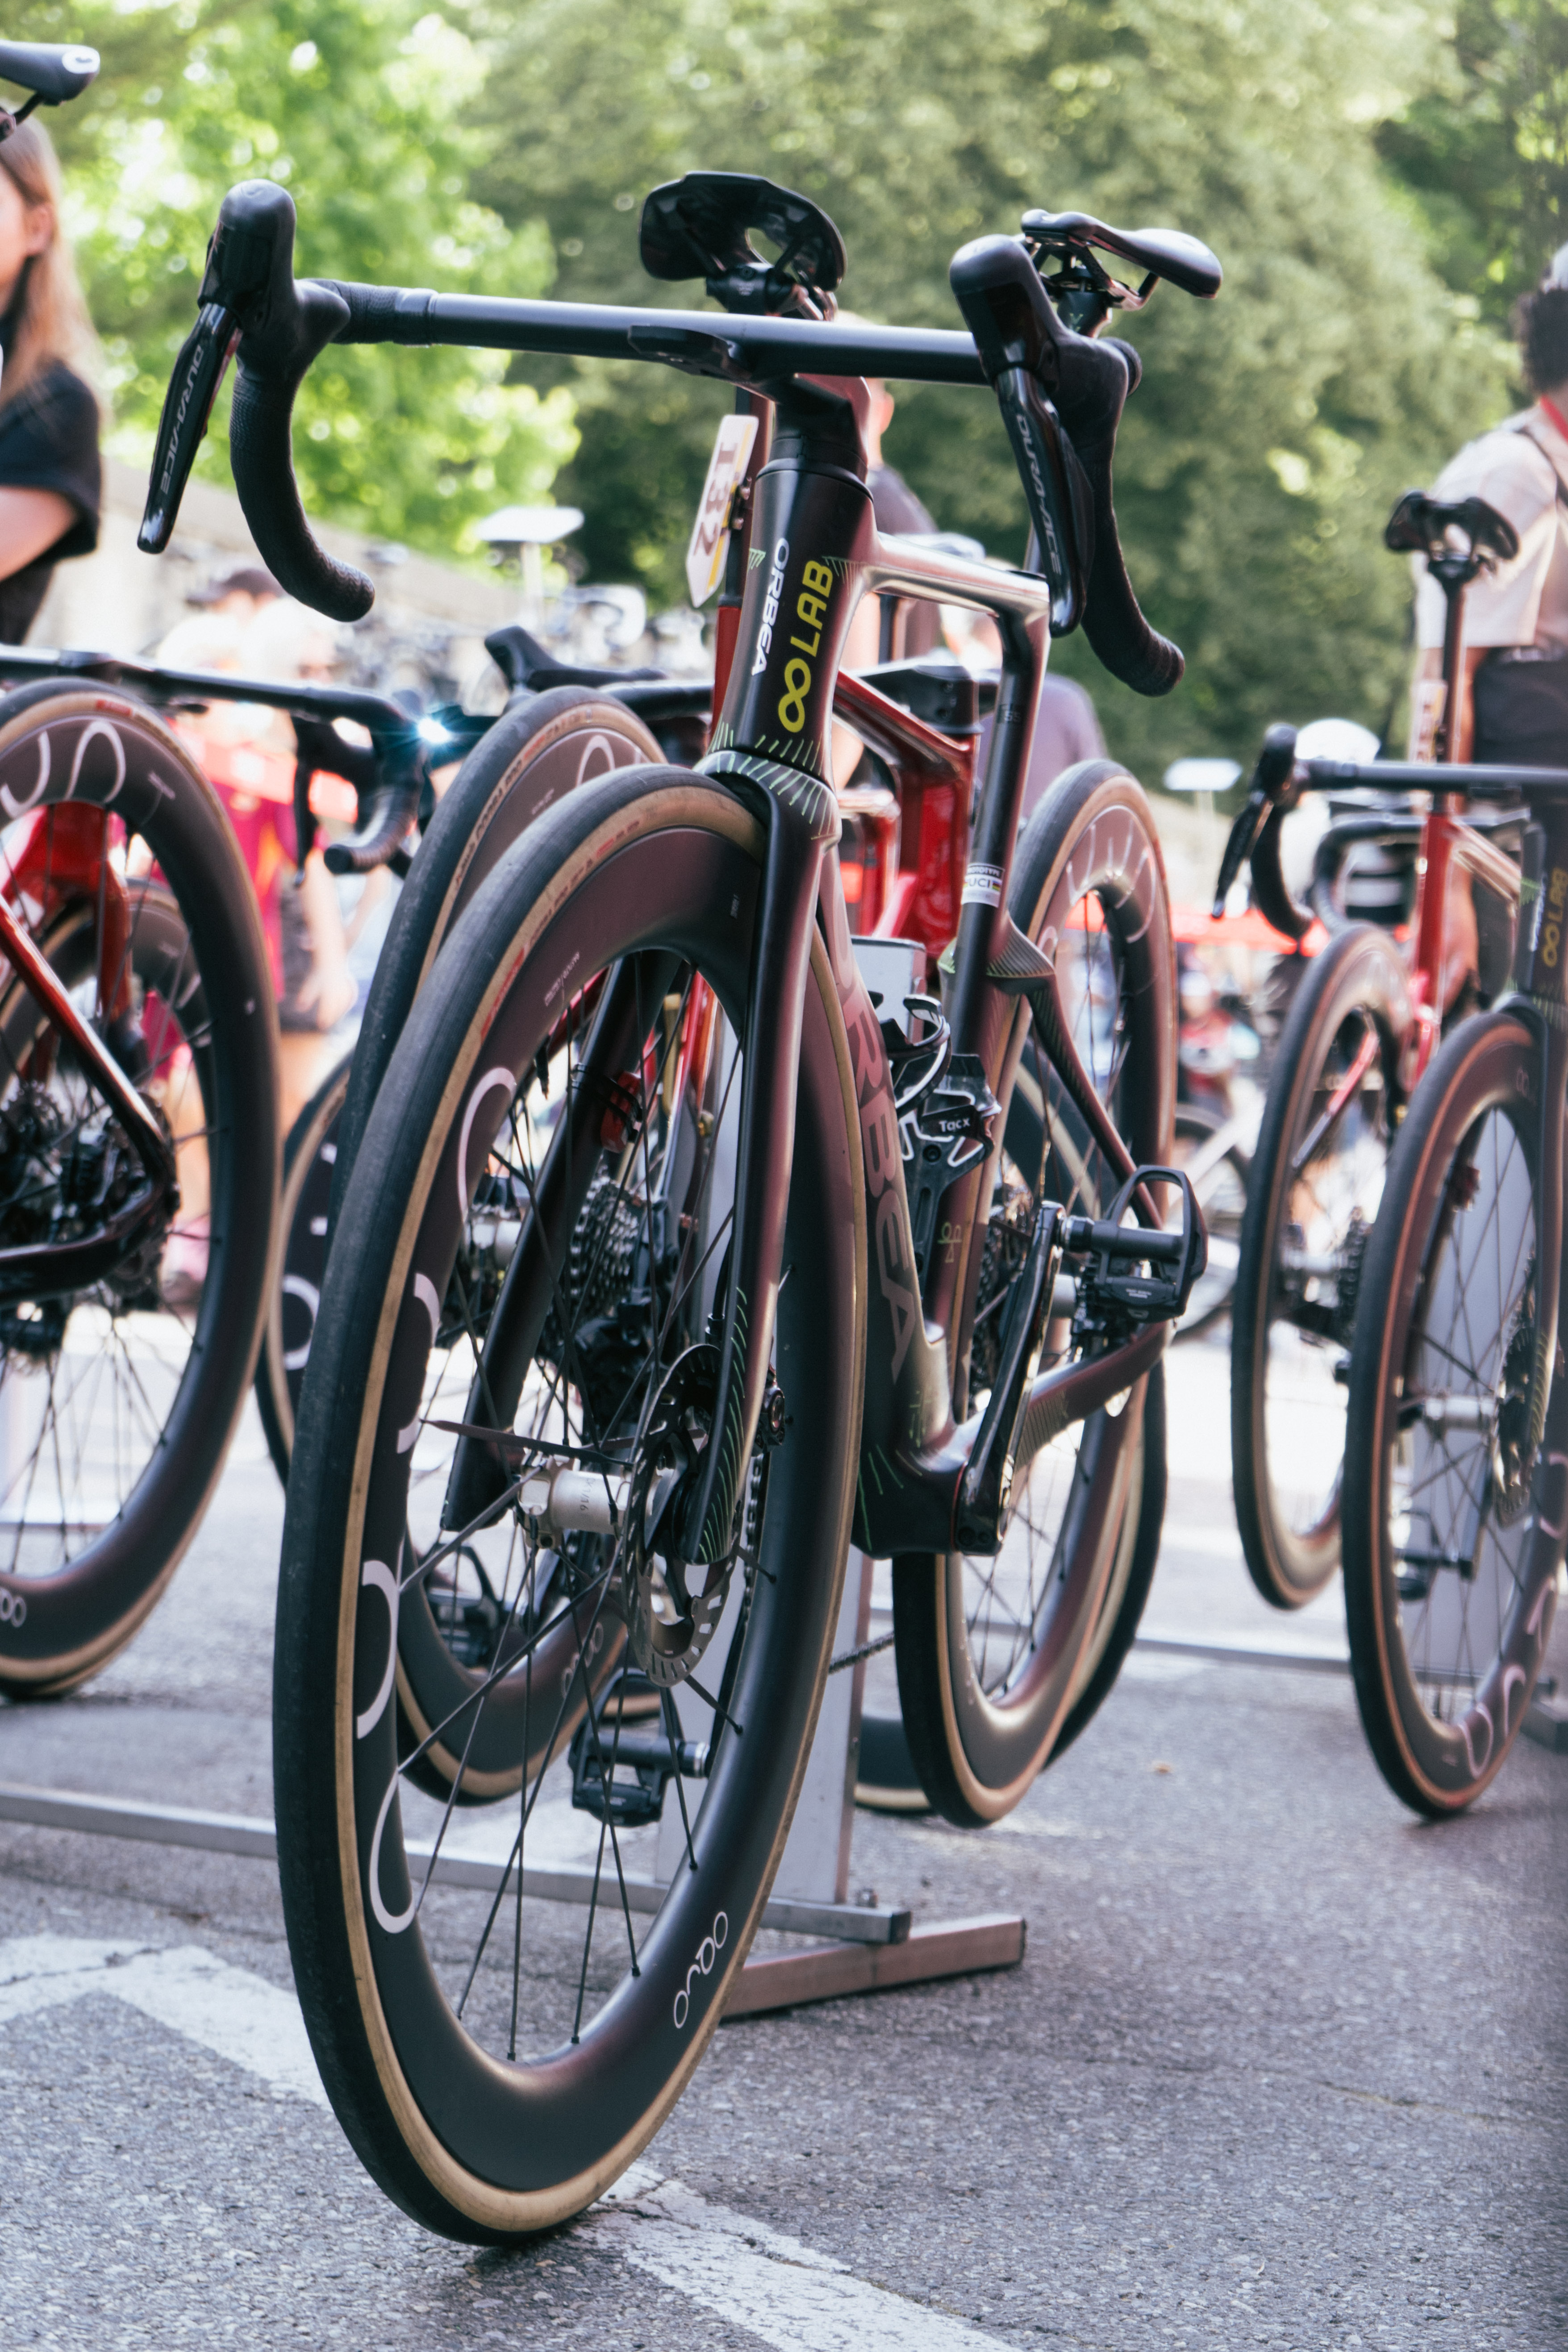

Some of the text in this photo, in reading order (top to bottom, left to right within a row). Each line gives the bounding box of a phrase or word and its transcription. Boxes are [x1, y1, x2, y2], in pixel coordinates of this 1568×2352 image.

[161, 344, 204, 494] DURA-ACE
[693, 442, 738, 557] 132
[1016, 414, 1062, 575] DURA-ACE
[751, 537, 790, 676] ORBEA
[969, 878, 991, 888] UCI
[938, 1118, 971, 1132] Tacx
